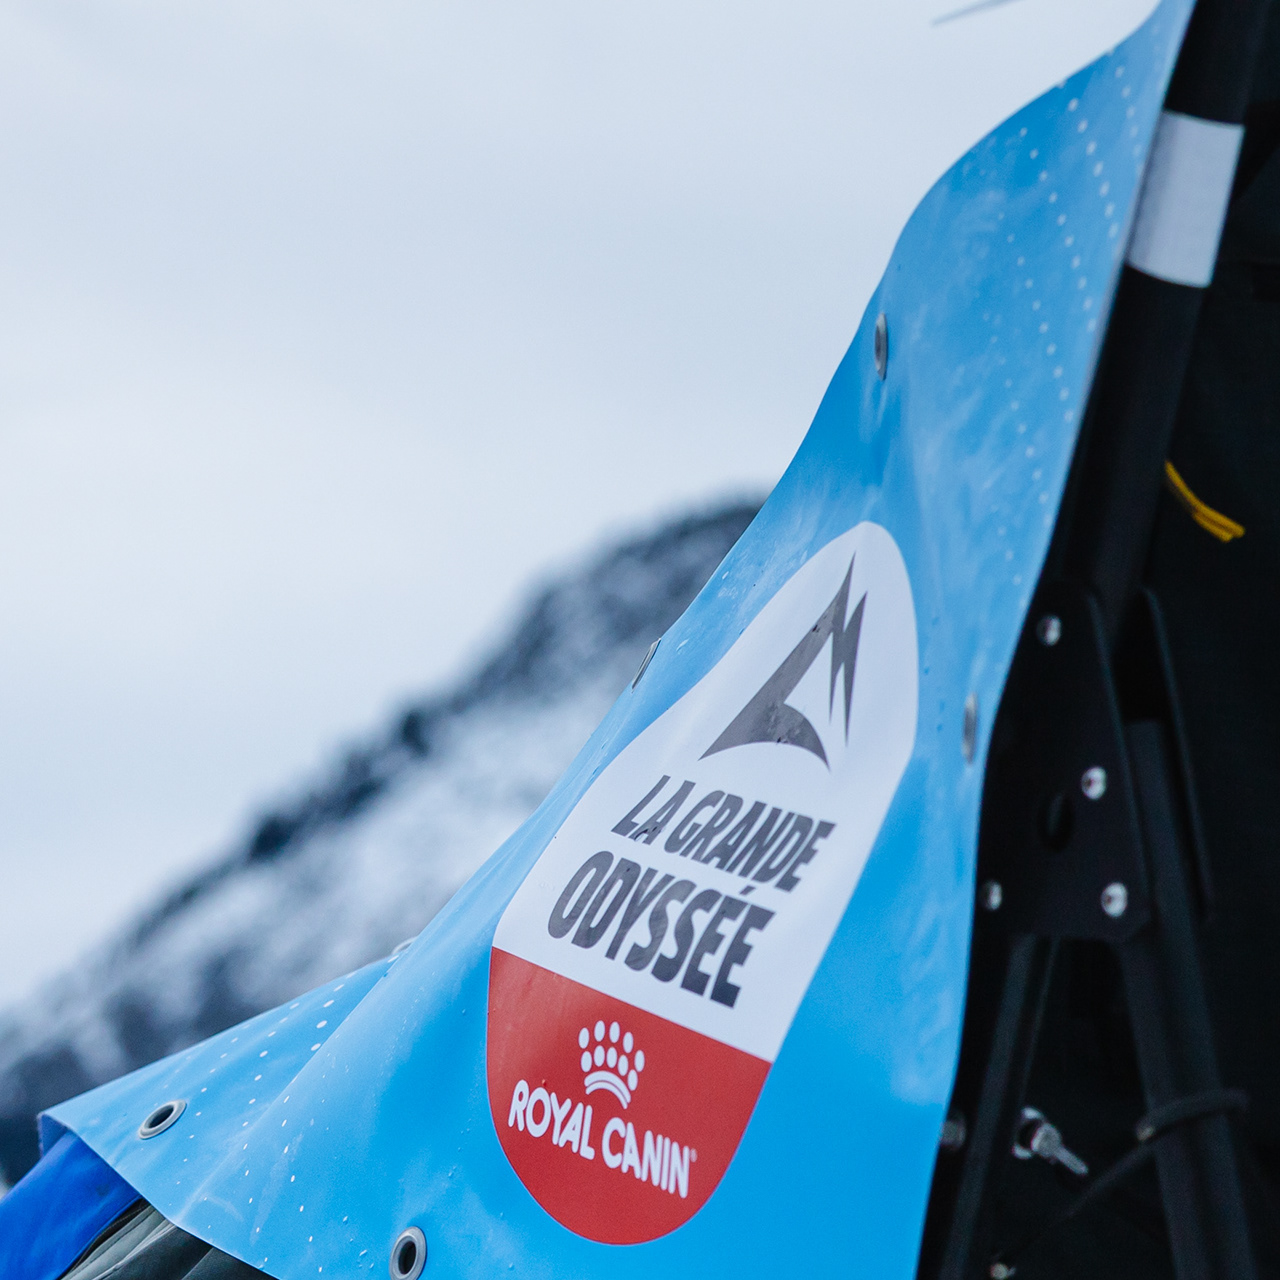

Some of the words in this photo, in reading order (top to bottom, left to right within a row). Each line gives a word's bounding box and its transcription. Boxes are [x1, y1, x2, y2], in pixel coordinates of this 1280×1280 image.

[611, 775, 696, 845] LA
[664, 790, 837, 893] GRANDE
[548, 850, 777, 1009] ODYSSÉE
[508, 1079, 595, 1160] ROYAL
